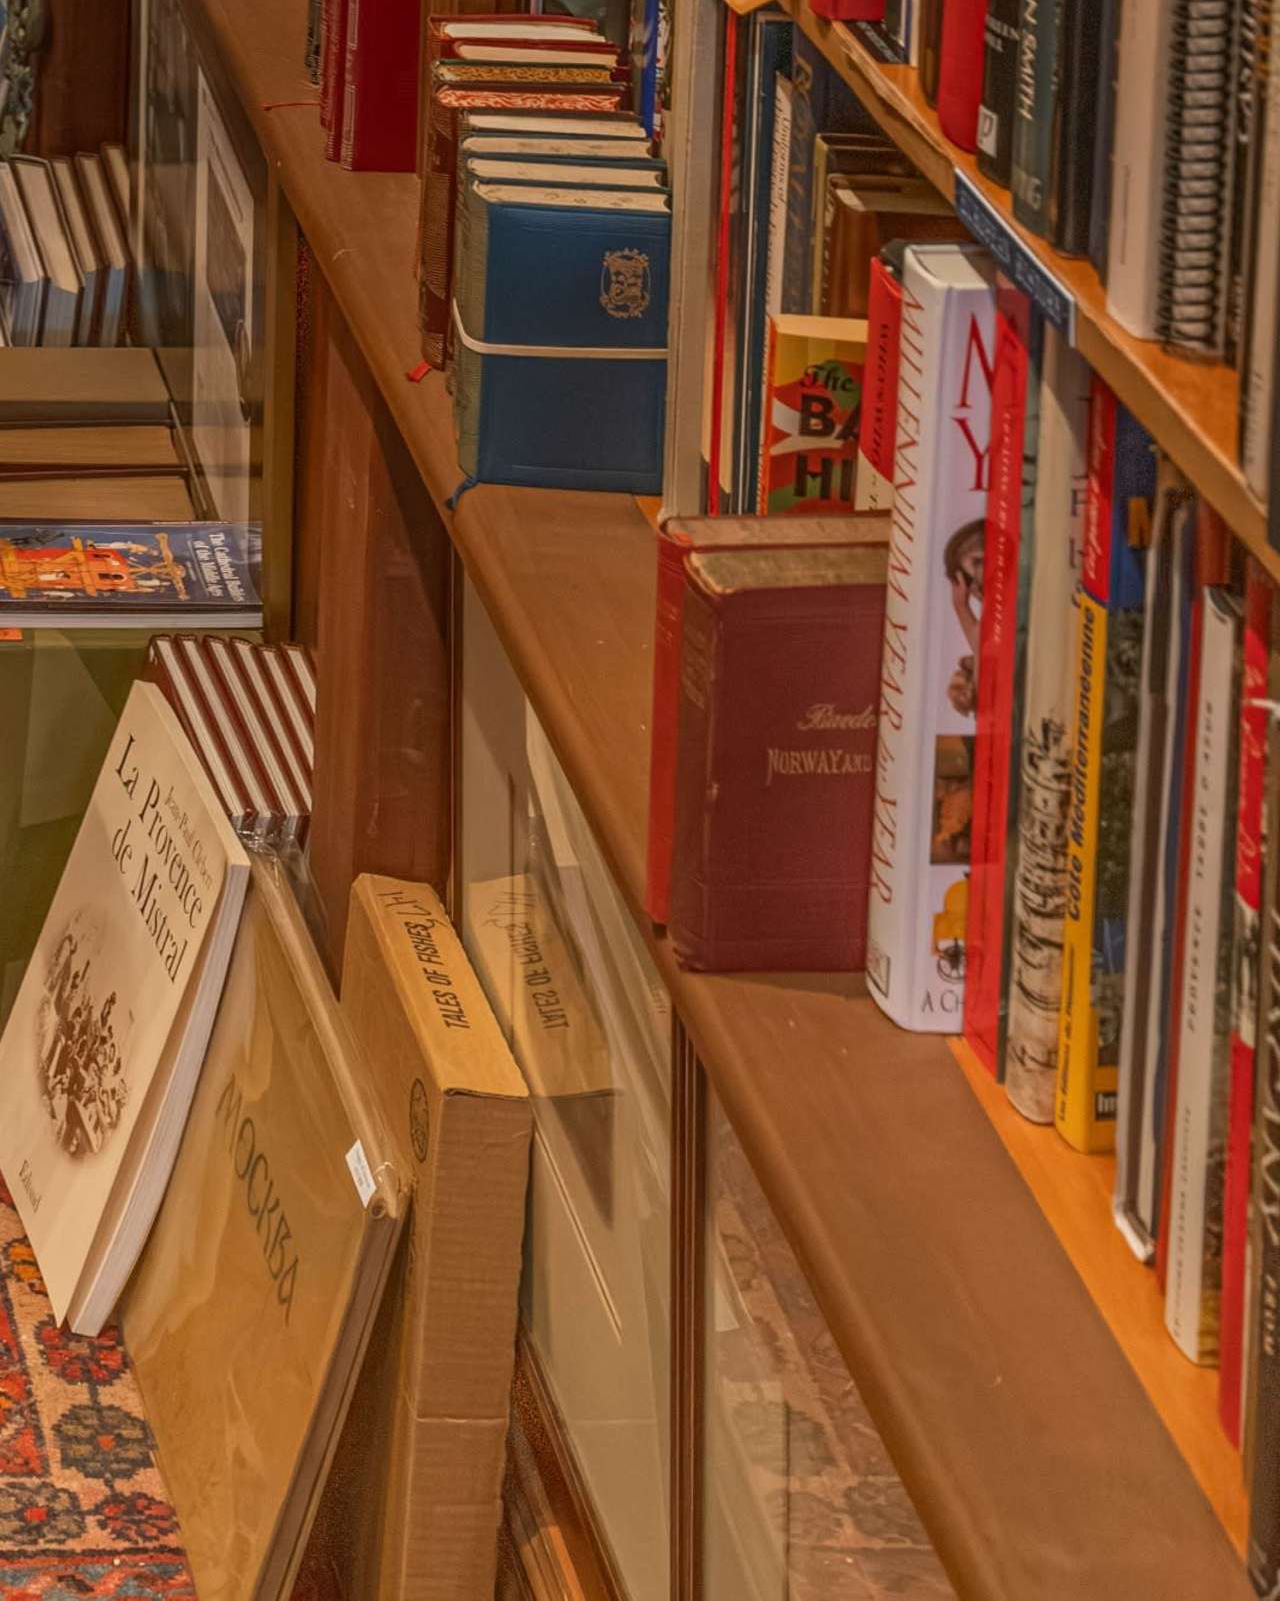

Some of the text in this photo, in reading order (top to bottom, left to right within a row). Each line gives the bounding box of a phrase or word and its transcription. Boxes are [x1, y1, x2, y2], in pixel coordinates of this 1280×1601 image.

[1017, 32, 1038, 121] SMITH
[801, 362, 857, 393] The
[887, 287, 925, 603] MILLENNIUM
[200, 562, 220, 585] Middle
[214, 547, 239, 580] Cathedral
[879, 615, 909, 731] YEAR
[768, 747, 842, 787] NORWAY
[113, 733, 208, 931] La Provence
[870, 797, 898, 905] YEAR
[111, 818, 189, 986] de Mistral
[404, 920, 446, 969] FISHES
[425, 965, 454, 996] OF
[920, 990, 935, 1013] A
[443, 989, 472, 1030] TALES
